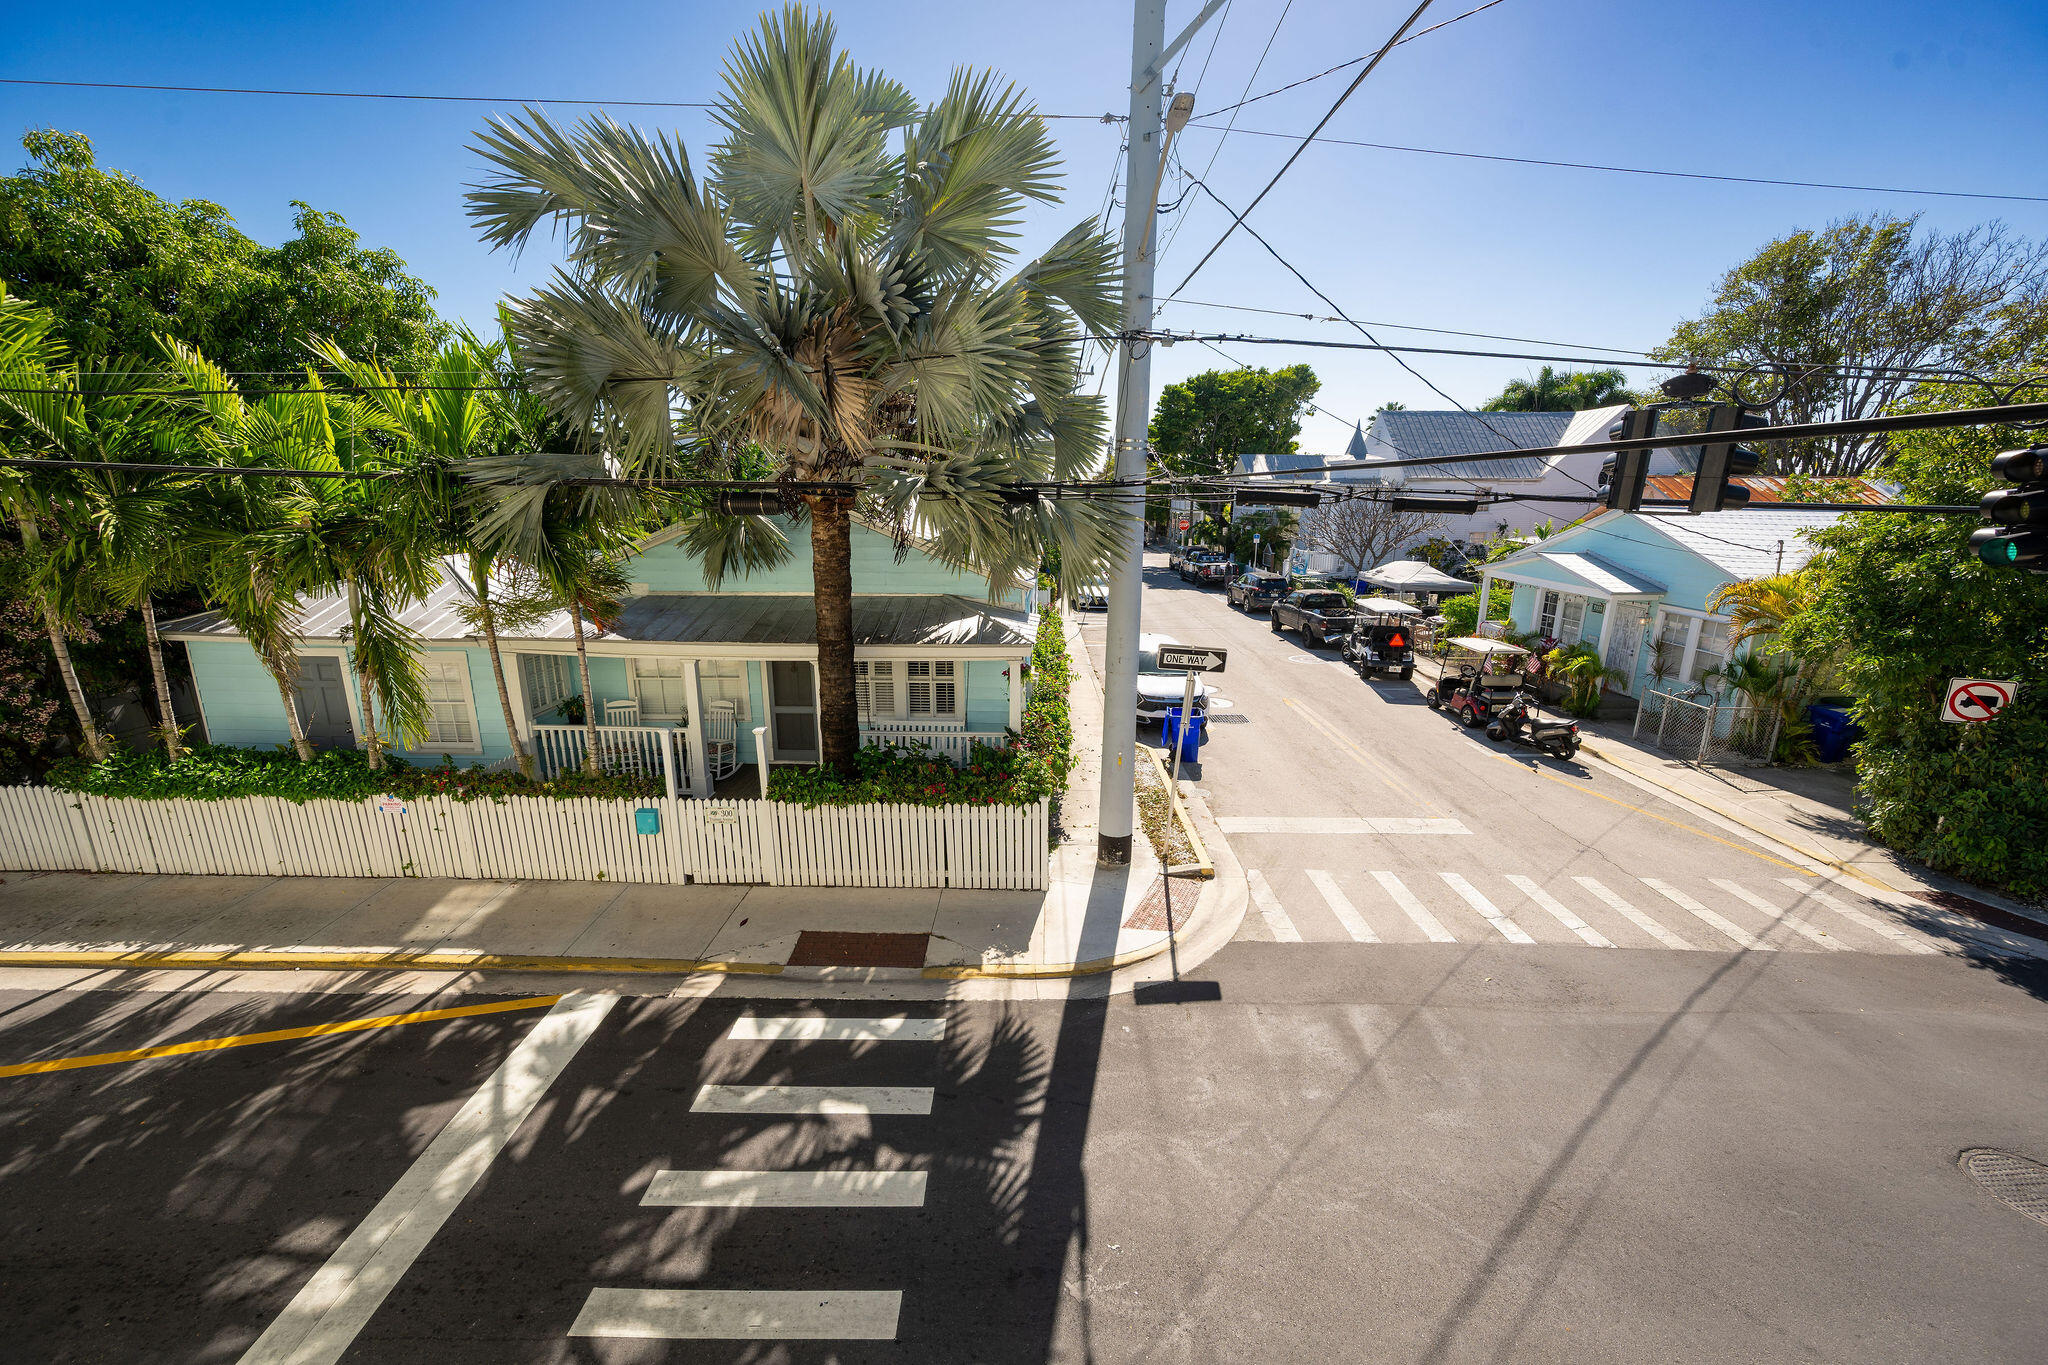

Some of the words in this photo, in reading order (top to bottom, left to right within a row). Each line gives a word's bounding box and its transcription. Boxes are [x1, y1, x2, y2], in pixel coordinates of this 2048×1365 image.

[1166, 654, 1184, 663] ONE
[1187, 655, 1206, 664] WAY
[720, 809, 733, 817] 300
